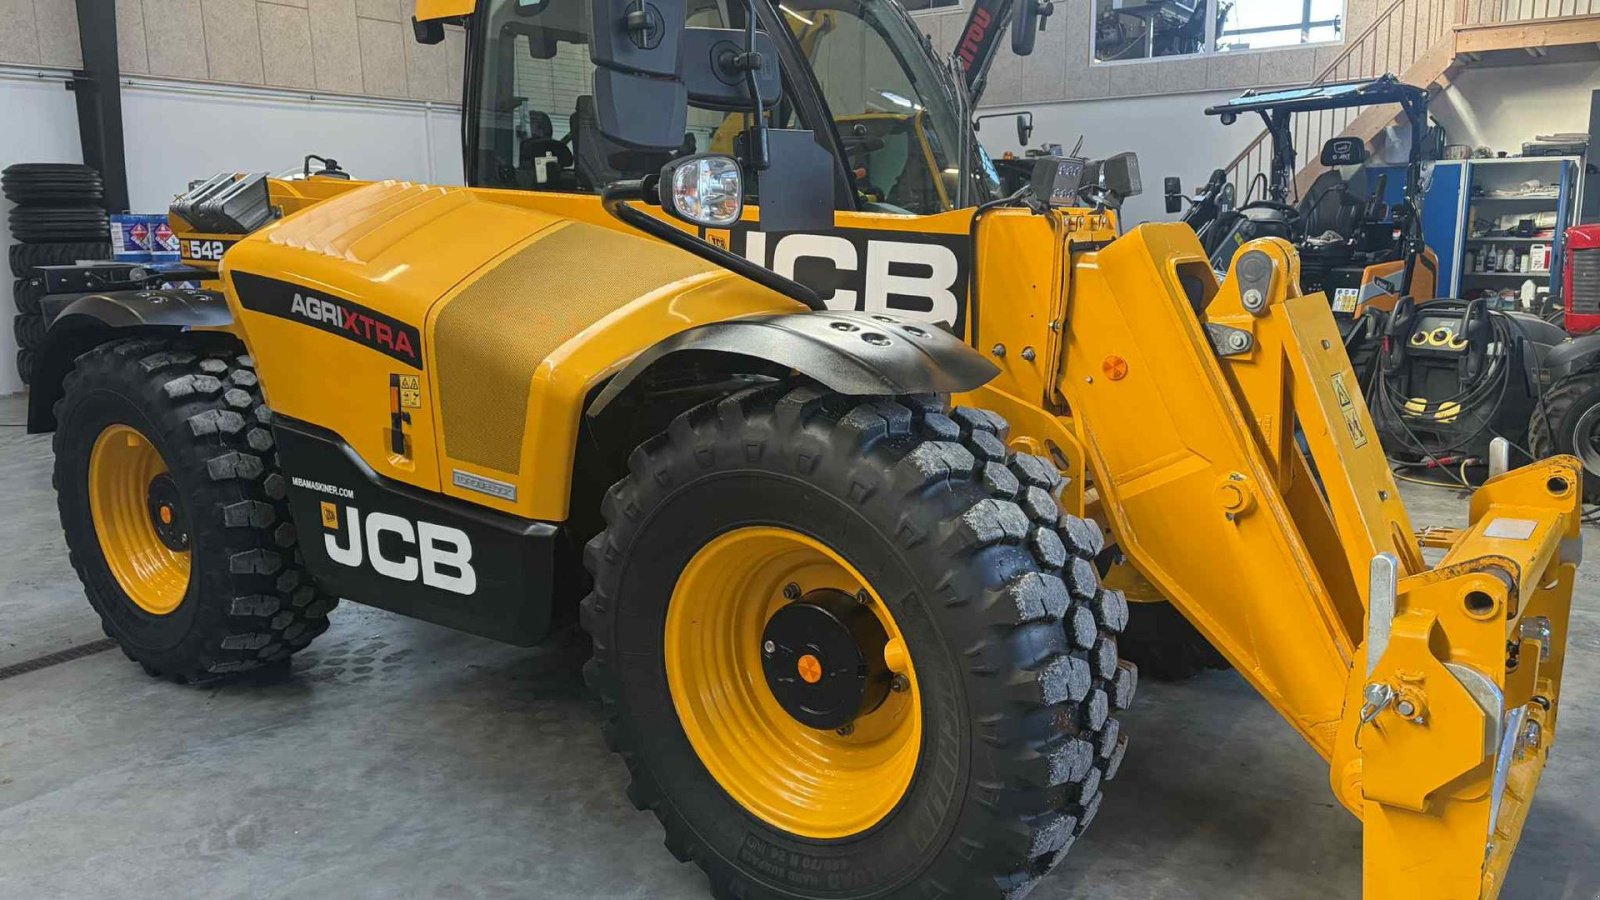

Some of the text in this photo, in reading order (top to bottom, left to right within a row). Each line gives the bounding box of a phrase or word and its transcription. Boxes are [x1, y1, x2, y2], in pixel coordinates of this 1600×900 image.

[190, 240, 224, 260] 542
[290, 292, 416, 359] AGRIXTRA
[291, 476, 355, 499] MIBAMASKINER.COM
[323, 505, 477, 596] JCB
